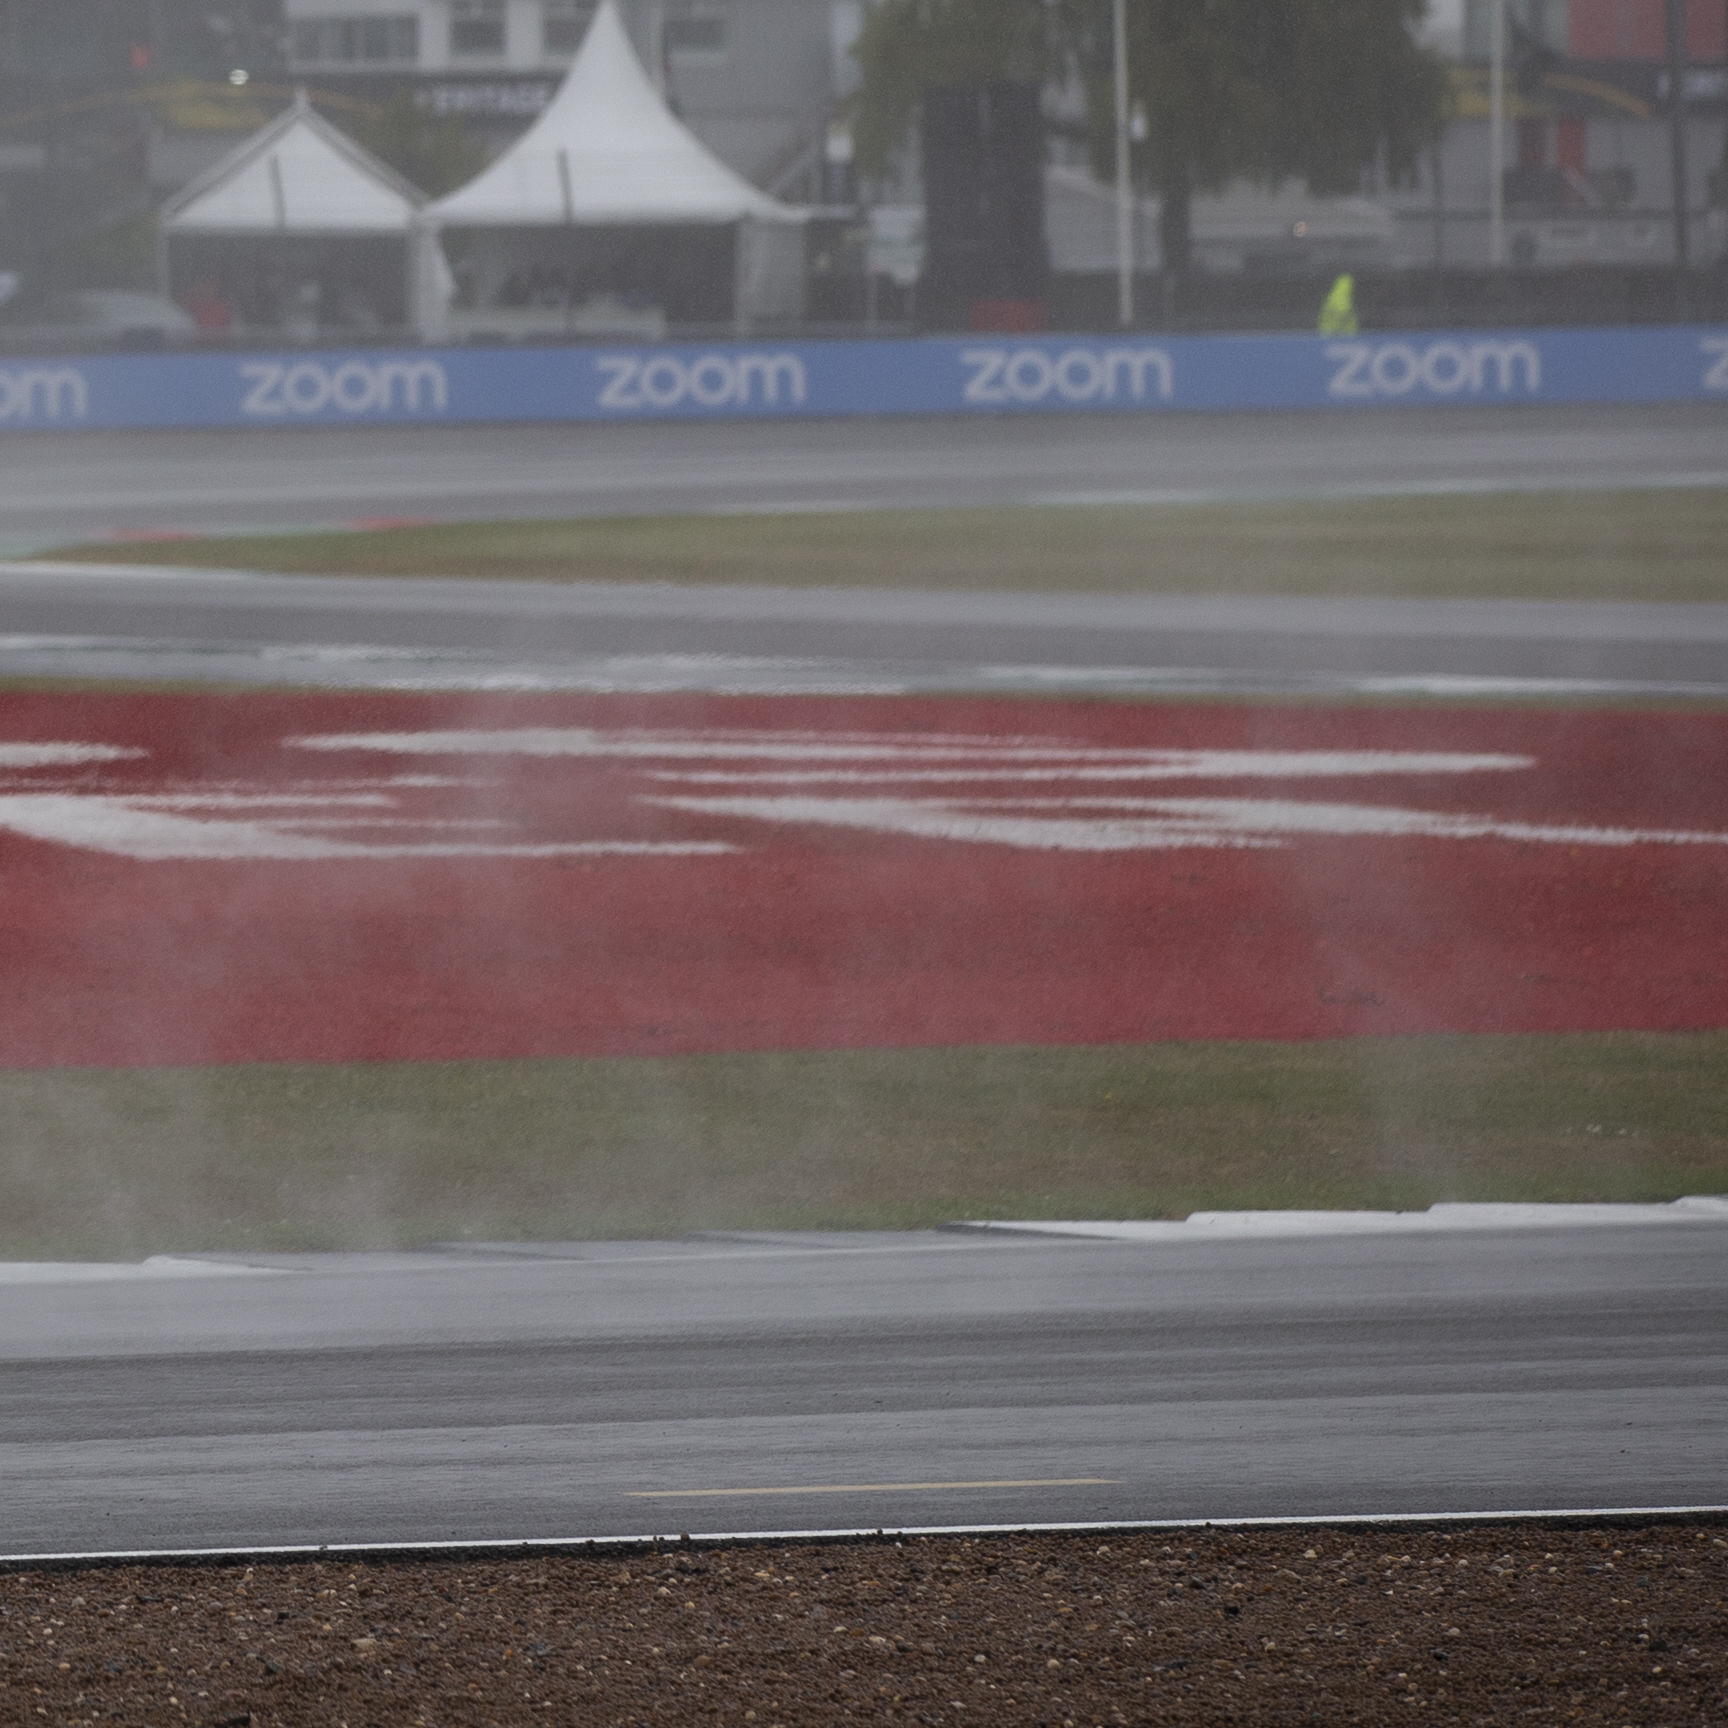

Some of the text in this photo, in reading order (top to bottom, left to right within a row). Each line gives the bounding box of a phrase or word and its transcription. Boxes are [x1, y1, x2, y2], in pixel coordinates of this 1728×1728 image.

[241, 361, 446, 414] zoom
[597, 355, 804, 407] zoom
[963, 349, 1172, 401] zoom
[1327, 343, 1539, 395] zoom
